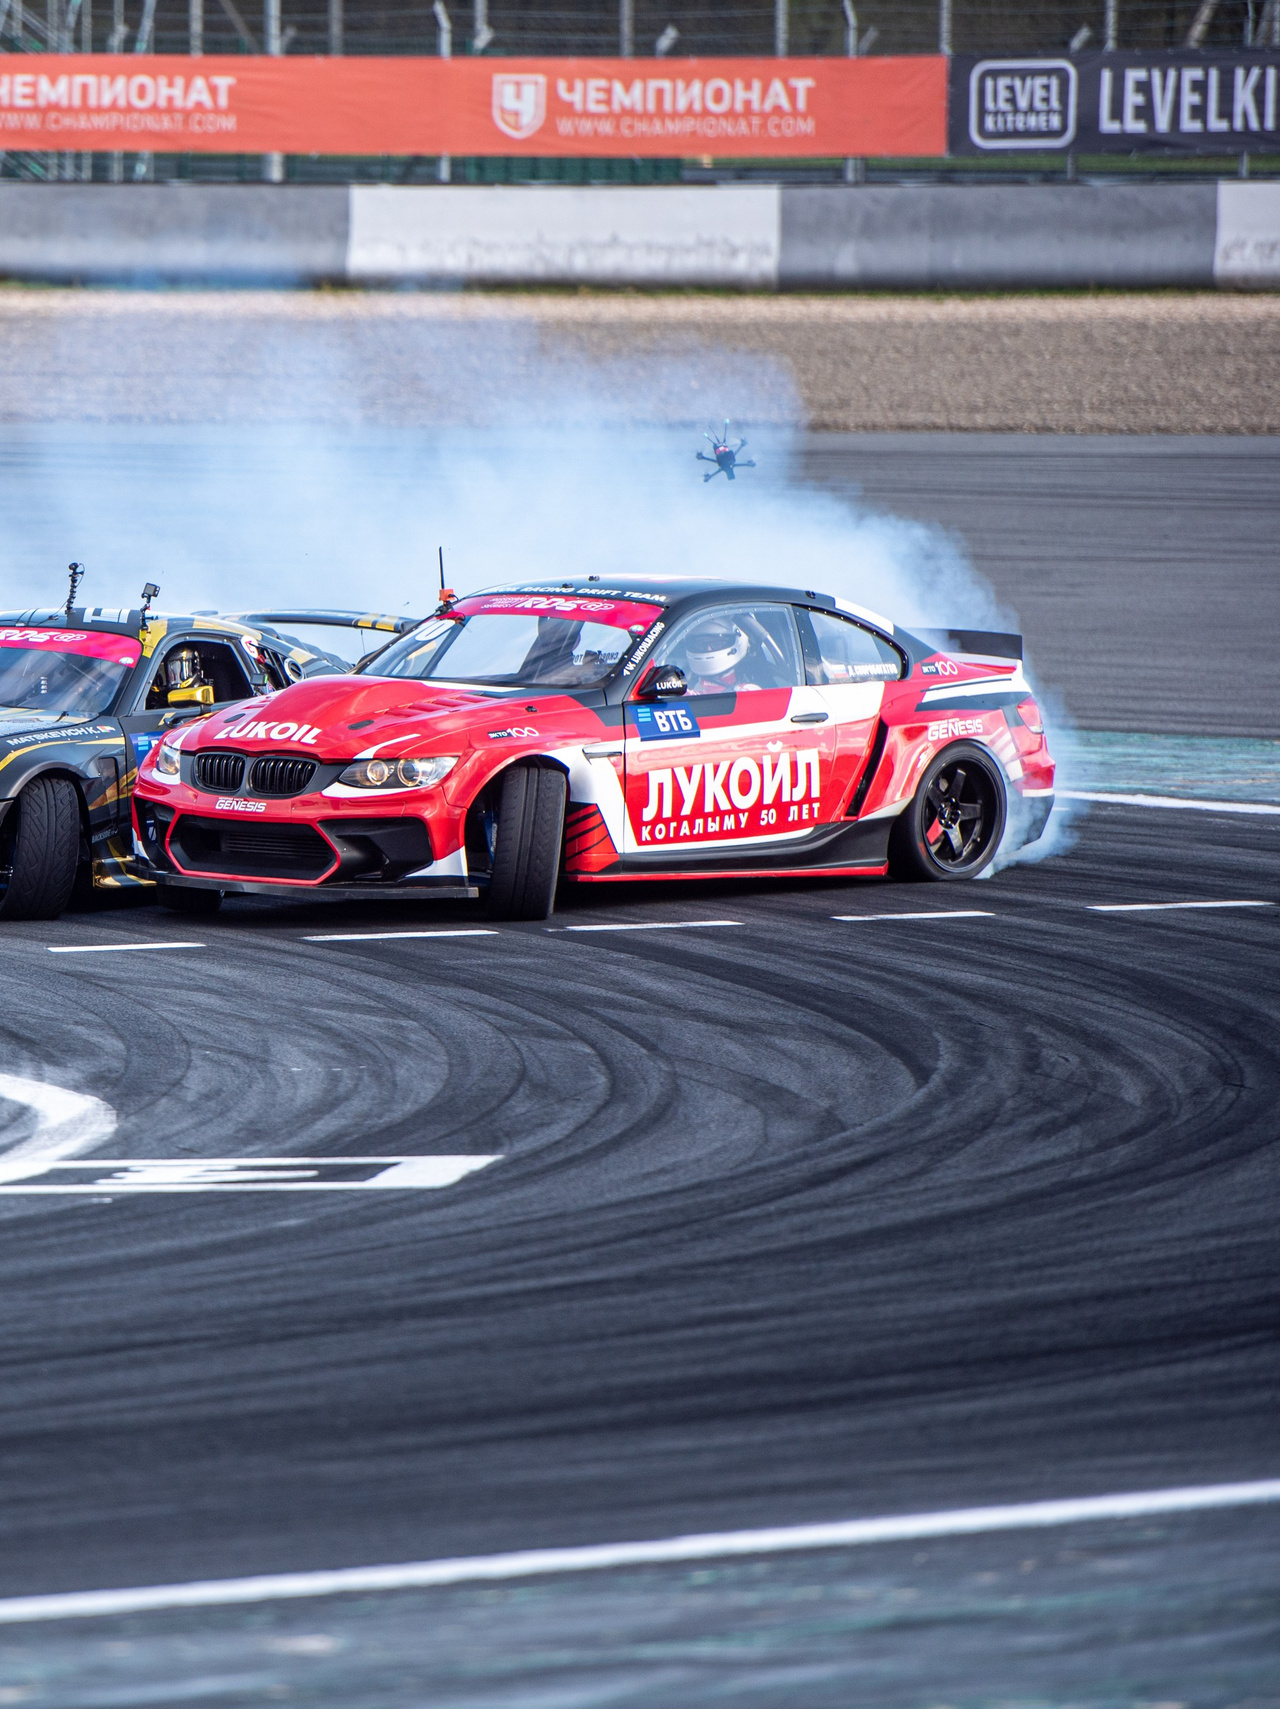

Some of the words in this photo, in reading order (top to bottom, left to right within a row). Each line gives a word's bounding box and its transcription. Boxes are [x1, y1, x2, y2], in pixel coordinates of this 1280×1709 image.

[556, 77, 817, 114] ЧЕМПИОНАТ
[984, 75, 1062, 112] LEVEL
[1098, 65, 1279, 134] LEVELKI
[984, 111, 1062, 132] KITCHEN
[515, 596, 589, 611] RDS
[577, 588, 622, 597] DRIFT
[623, 591, 667, 602] TEAM
[630, 621, 666, 665] LUKOILRACING
[934, 661, 958, 676] 100
[656, 680, 683, 690] LUKOIL
[653, 709, 693, 732] ВТБ
[927, 719, 984, 741] GENESIS
[6, 728, 87, 746] MATSKEVICH
[213, 721, 322, 744] LUKOIL
[506, 727, 540, 738] 100
[642, 740, 821, 822] ЛУКОЙЛ
[215, 800, 267, 813] GENESIS
[641, 812, 749, 842] КОГАЛЫМУ
[760, 808, 777, 826] 50
[788, 802, 821, 822] ЛЕТ
